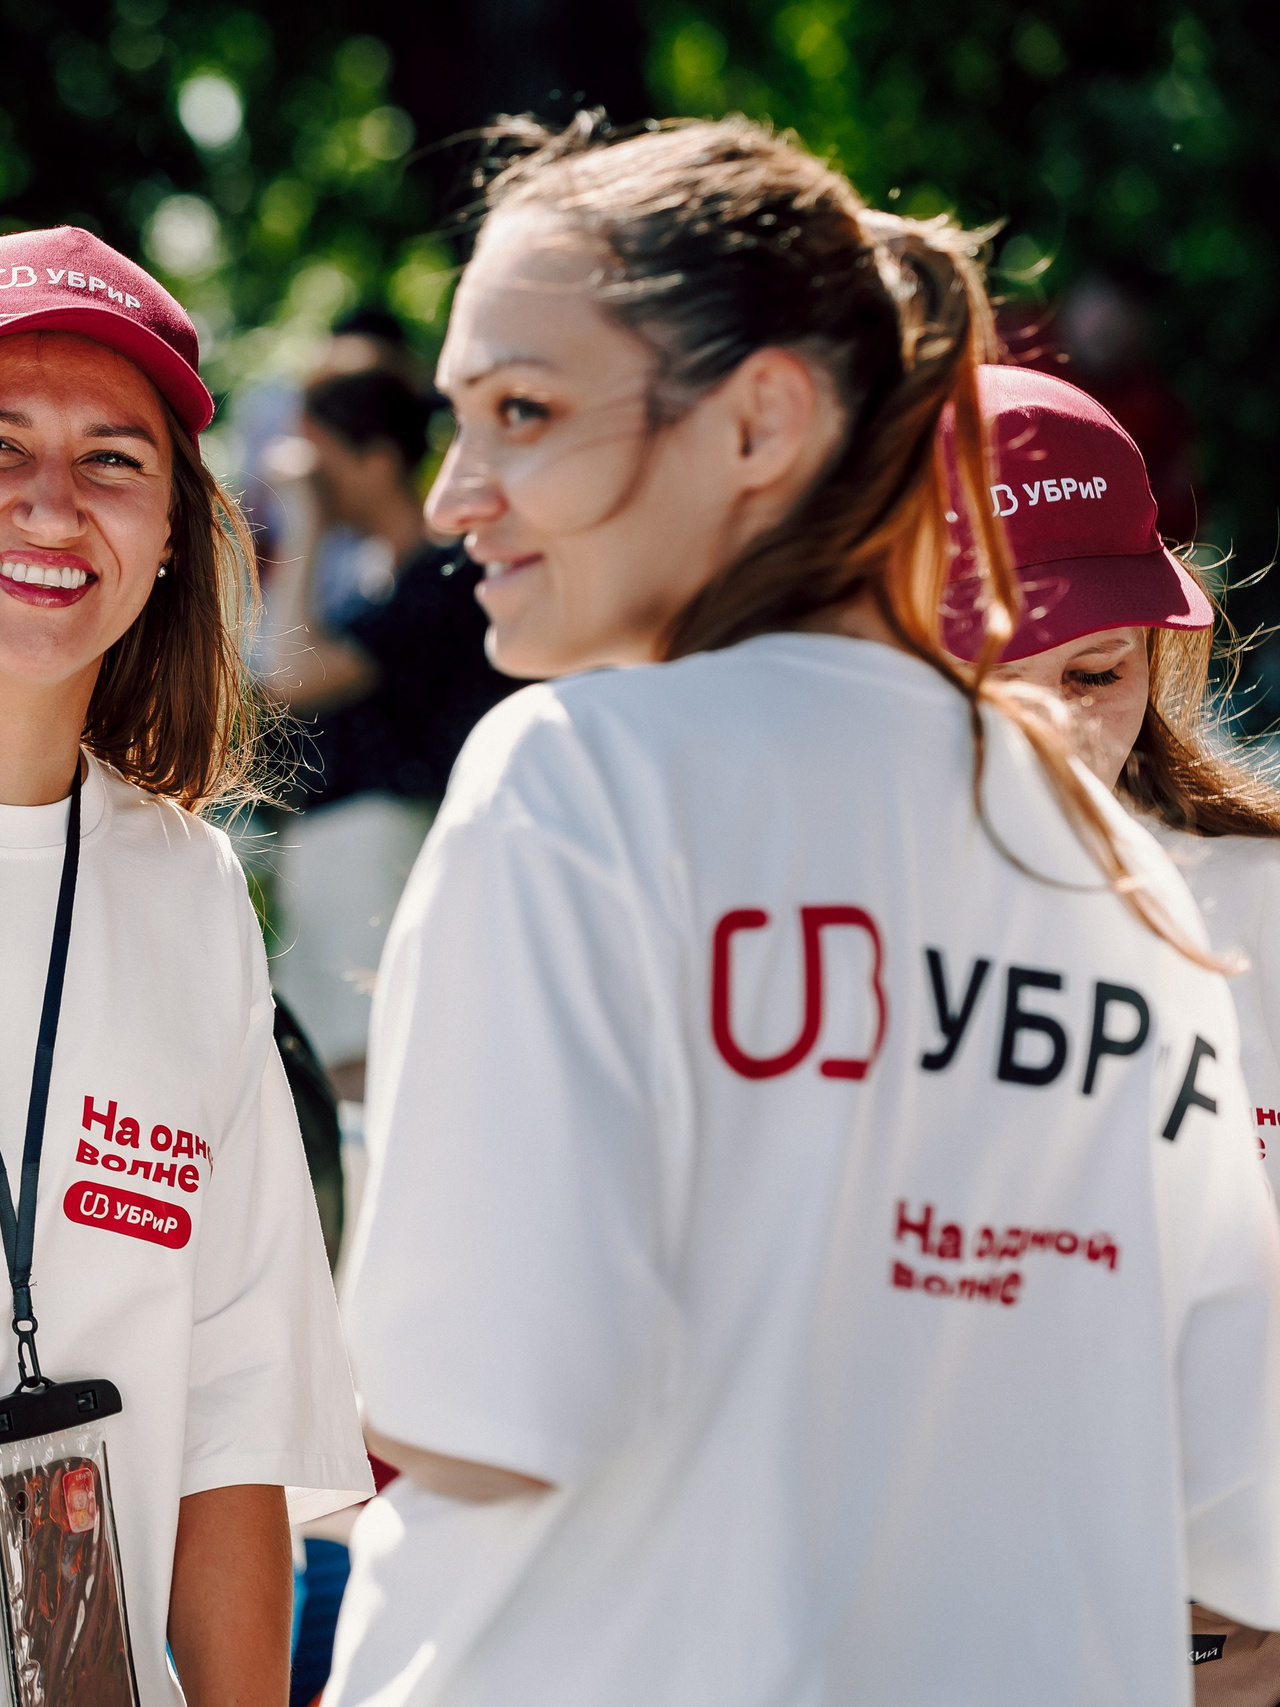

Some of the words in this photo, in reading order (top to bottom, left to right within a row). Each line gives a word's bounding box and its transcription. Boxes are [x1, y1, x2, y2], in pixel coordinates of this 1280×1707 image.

[45, 267, 141, 309] УБРиР
[1022, 476, 1108, 506] УБРиР
[920, 946, 1219, 1143] УБРР
[81, 1094, 140, 1149] На
[150, 1124, 214, 1176] одн
[75, 1138, 200, 1193] волне
[113, 1200, 178, 1234] УБРиР
[895, 1200, 962, 1259] На
